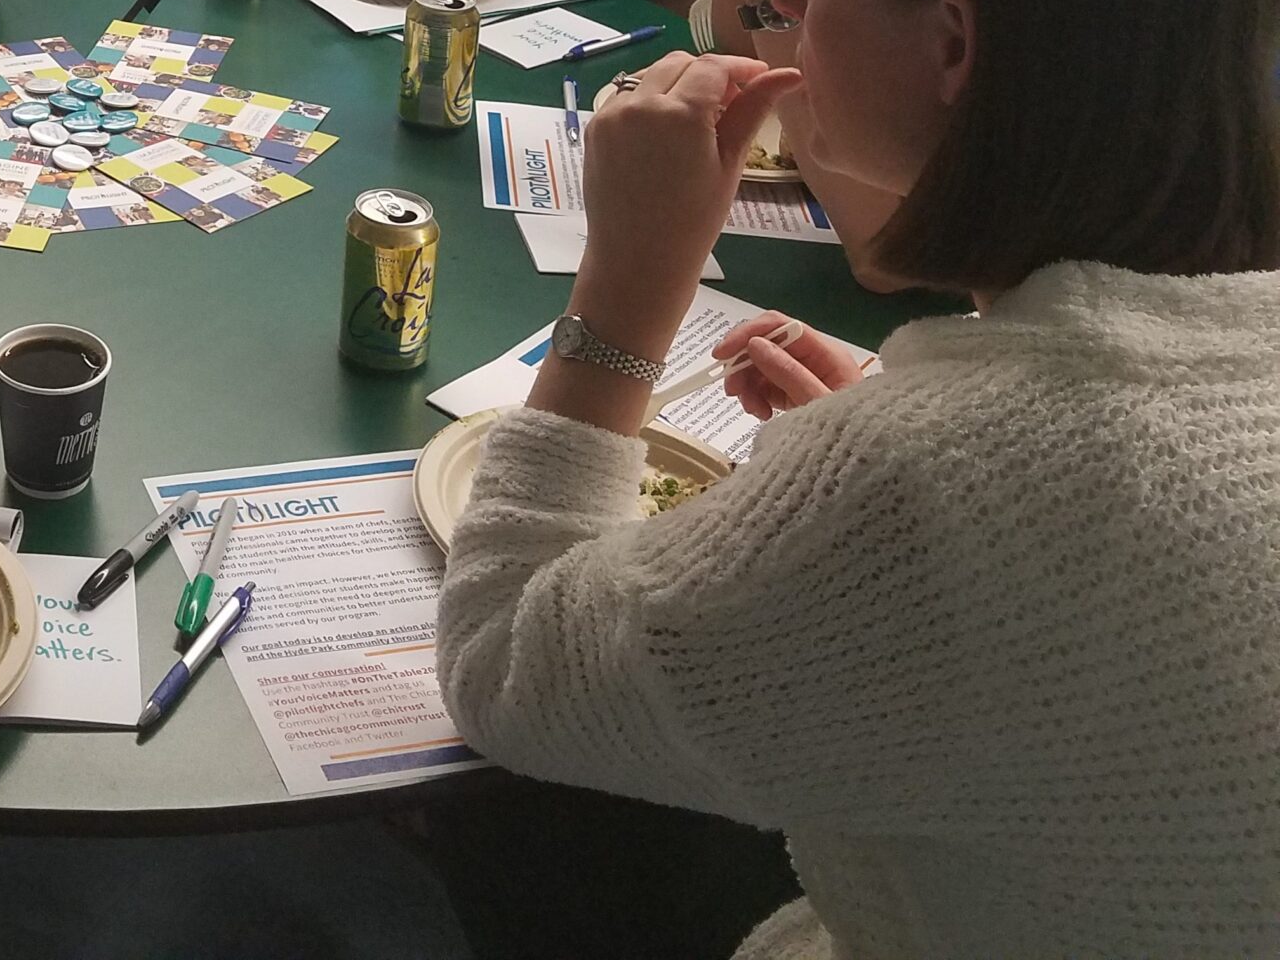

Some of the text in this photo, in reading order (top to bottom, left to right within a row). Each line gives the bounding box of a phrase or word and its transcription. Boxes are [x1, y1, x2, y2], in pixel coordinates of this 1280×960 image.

[392, 247, 432, 305] La
[263, 496, 339, 520] LIGHT
[224, 540, 285, 552] professionals
[310, 533, 348, 542] together
[359, 528, 396, 536] develop
[238, 550, 278, 558] students
[316, 540, 360, 549] attitudes,
[275, 554, 317, 563] healthier
[316, 550, 351, 558] choices
[277, 589, 320, 598] decisions
[339, 582, 379, 591] students
[406, 575, 441, 583] happen
[273, 599, 319, 609] recognize
[372, 588, 407, 597] deepen
[285, 605, 346, 616] communities
[43, 620, 94, 637] oice
[275, 620, 306, 628] served
[241, 644, 260, 652] Our
[261, 641, 283, 649] goal
[283, 637, 313, 646] today
[335, 630, 374, 640] develop
[388, 624, 420, 633] action
[245, 653, 266, 661] and
[284, 647, 311, 656] Hyde
[311, 644, 335, 652] Park
[335, 637, 390, 649] community
[390, 632, 430, 642] through
[35, 638, 122, 662] atters.
[257, 662, 386, 685] Share our conversation!
[262, 687, 283, 695] Use
[303, 678, 351, 690] hashtags
[351, 667, 436, 683] #OnTheTable20
[371, 684, 392, 692] and
[393, 681, 411, 689] tag
[272, 699, 366, 718] @pilotlightchefs
[366, 696, 387, 705] and
[387, 693, 409, 702] The
[277, 714, 341, 729] Community
[370, 702, 428, 716] @chitrust
[283, 711, 448, 741] @thechicagocommunitytrust
[343, 735, 365, 743] and
